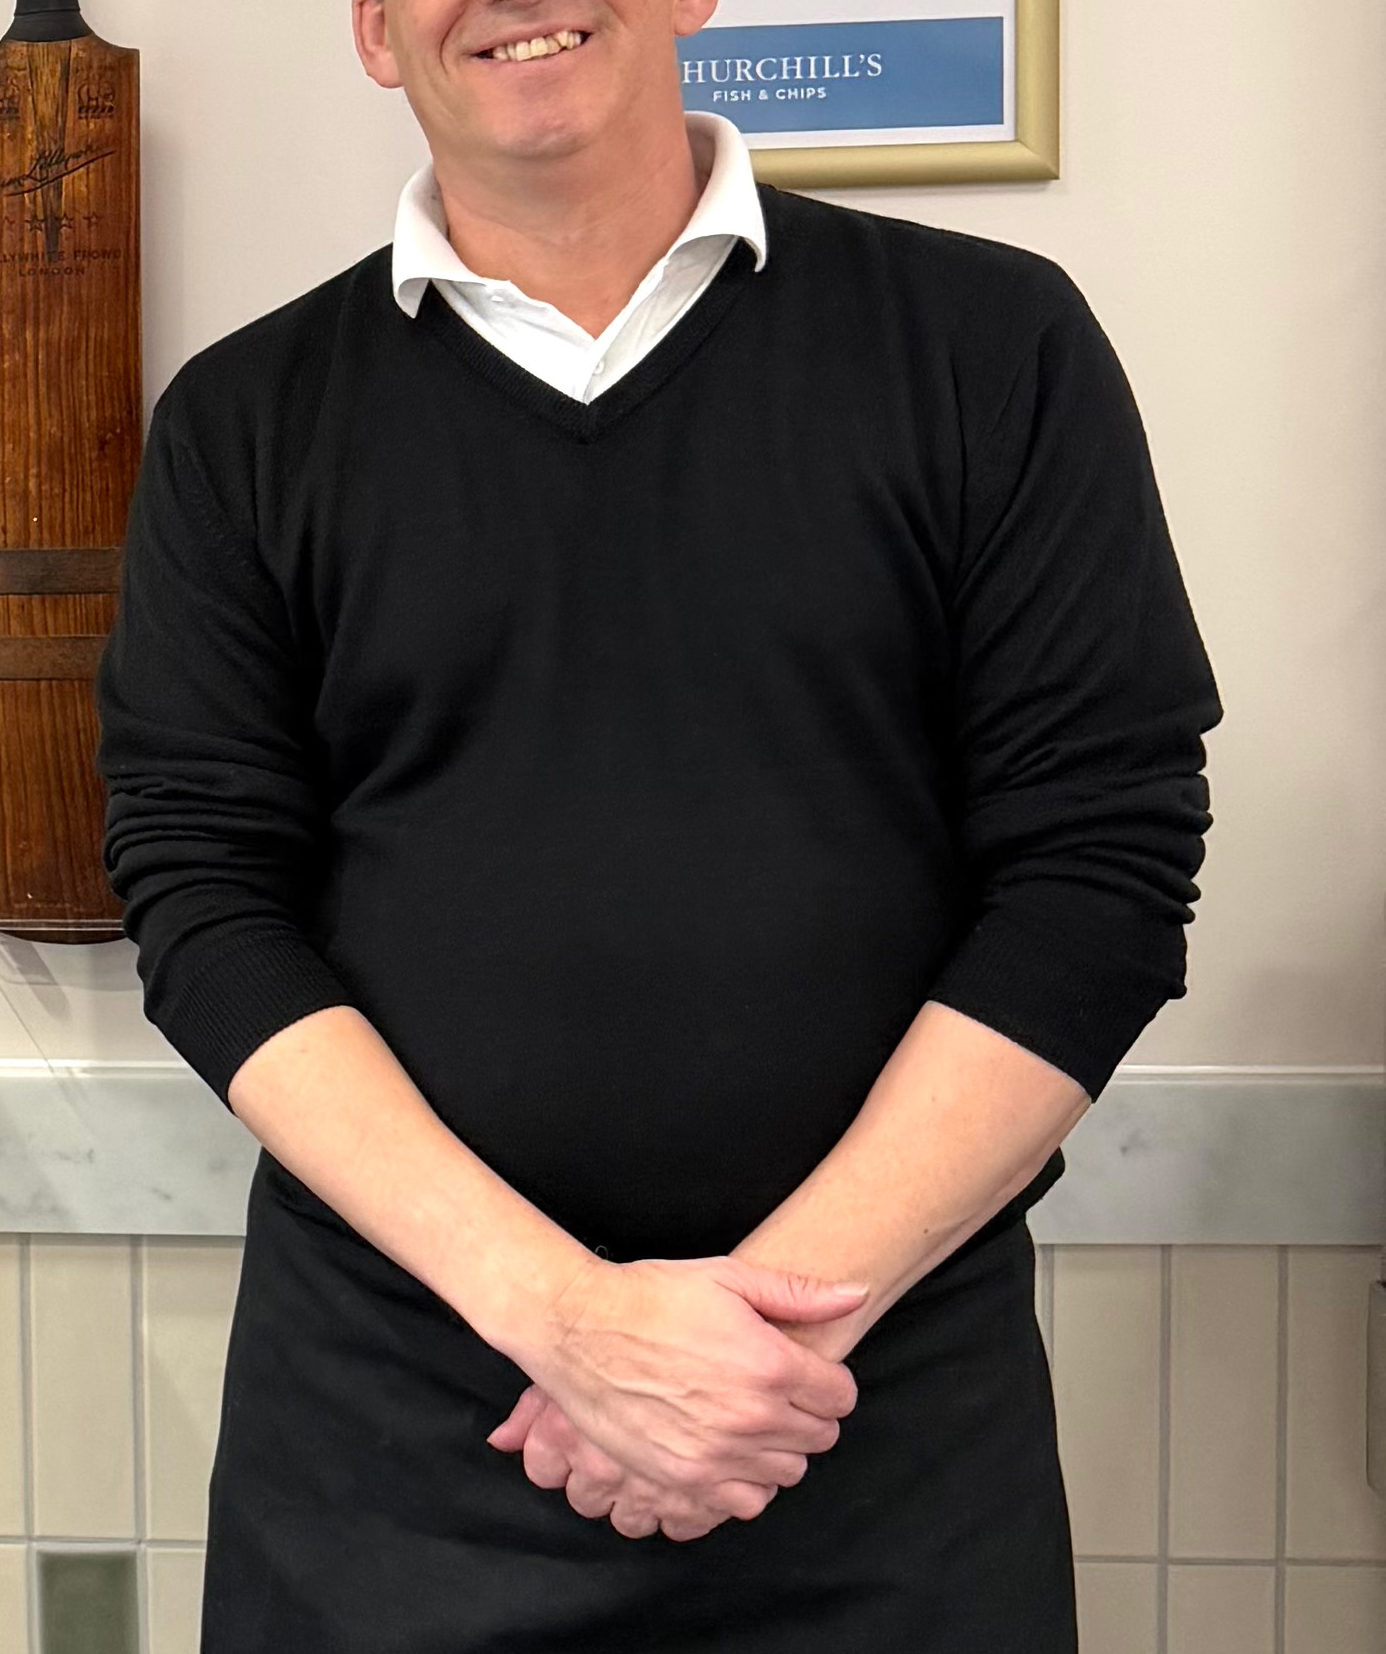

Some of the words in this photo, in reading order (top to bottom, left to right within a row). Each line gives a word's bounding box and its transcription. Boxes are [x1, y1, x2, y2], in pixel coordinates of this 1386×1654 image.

[682, 53, 881, 83] HURCHILL'S
[713, 89, 750, 102] FISH
[758, 89, 768, 100] &
[775, 87, 826, 99] CHIPS
